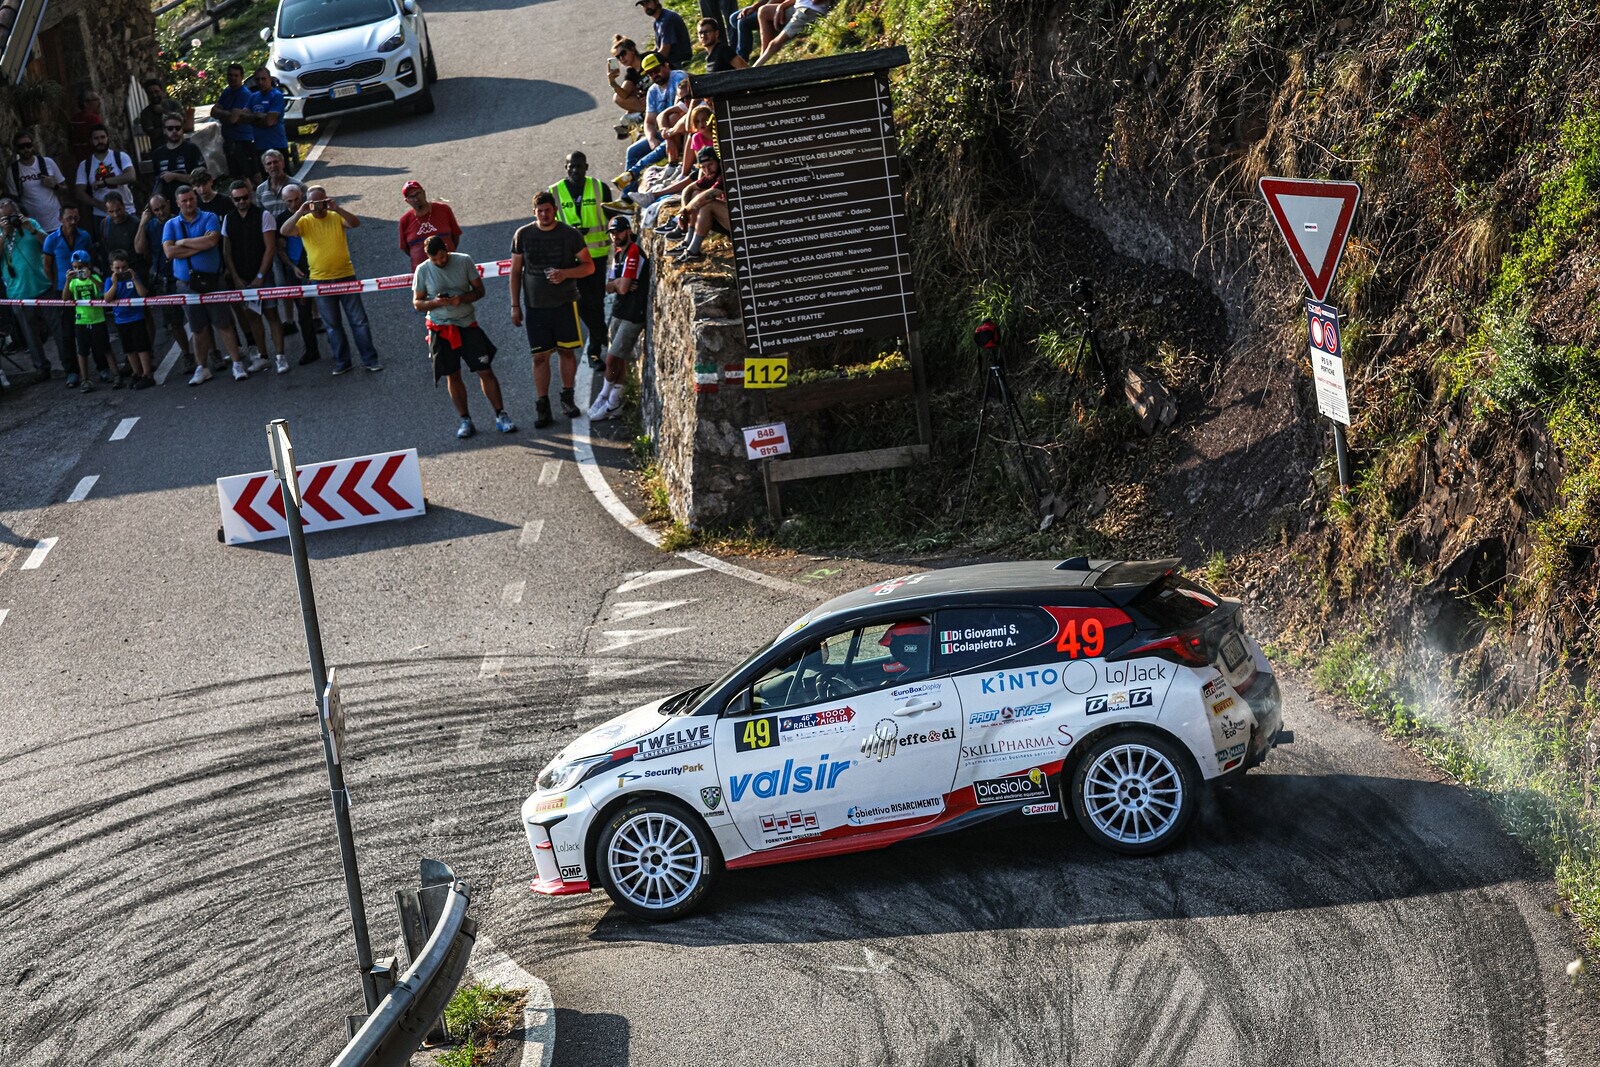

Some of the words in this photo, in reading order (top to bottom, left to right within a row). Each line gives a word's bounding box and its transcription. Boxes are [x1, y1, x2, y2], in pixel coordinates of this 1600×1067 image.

[731, 103, 762, 111] Ristorante
[733, 123, 765, 131] Ristorante
[738, 160, 770, 170] Alimentari
[784, 154, 816, 163] BOTTEGA
[741, 182, 767, 190] Hosteria
[815, 171, 844, 180] Livemmo
[744, 201, 776, 210] Ristorante
[819, 191, 848, 199] Livemmo
[746, 221, 778, 230] Ristorante
[752, 259, 788, 269] Agriturismo
[815, 250, 843, 259] QUISTINI
[793, 273, 823, 282] VECCHIO
[860, 265, 889, 273] Livemmo
[826, 288, 859, 297] Pierangelo
[782, 334, 811, 344] Breakfast
[746, 365, 786, 383] 112
[757, 428, 775, 438] B4B
[760, 446, 778, 455] B4B
[952, 630, 962, 640] Di
[964, 625, 1007, 639] Giovanni
[1009, 624, 1019, 634] S.
[1056, 618, 1105, 658] 49
[952, 639, 1003, 652] Colapietro
[1006, 637, 1016, 647] A.
[893, 682, 941, 696] EuroBoxDisplay
[821, 716, 848, 724] MIGLIA
[822, 709, 845, 718] 1000
[794, 720, 816, 729] RALLY
[636, 725, 710, 752] TWELVE
[743, 719, 770, 749] 49
[643, 742, 703, 758] ENTERTAINMENT
[961, 736, 1054, 758] SKILLPHARMA
[645, 763, 703, 777] SecurityPark
[729, 754, 850, 802] valsir
[977, 778, 1031, 796] biasiolo
[855, 807, 890, 818] obiettivo
[890, 798, 940, 812] RISARCIMENTO
[1031, 804, 1056, 813] Castrol
[766, 835, 792, 843] FORNITURE
[562, 867, 581, 876] OMP
